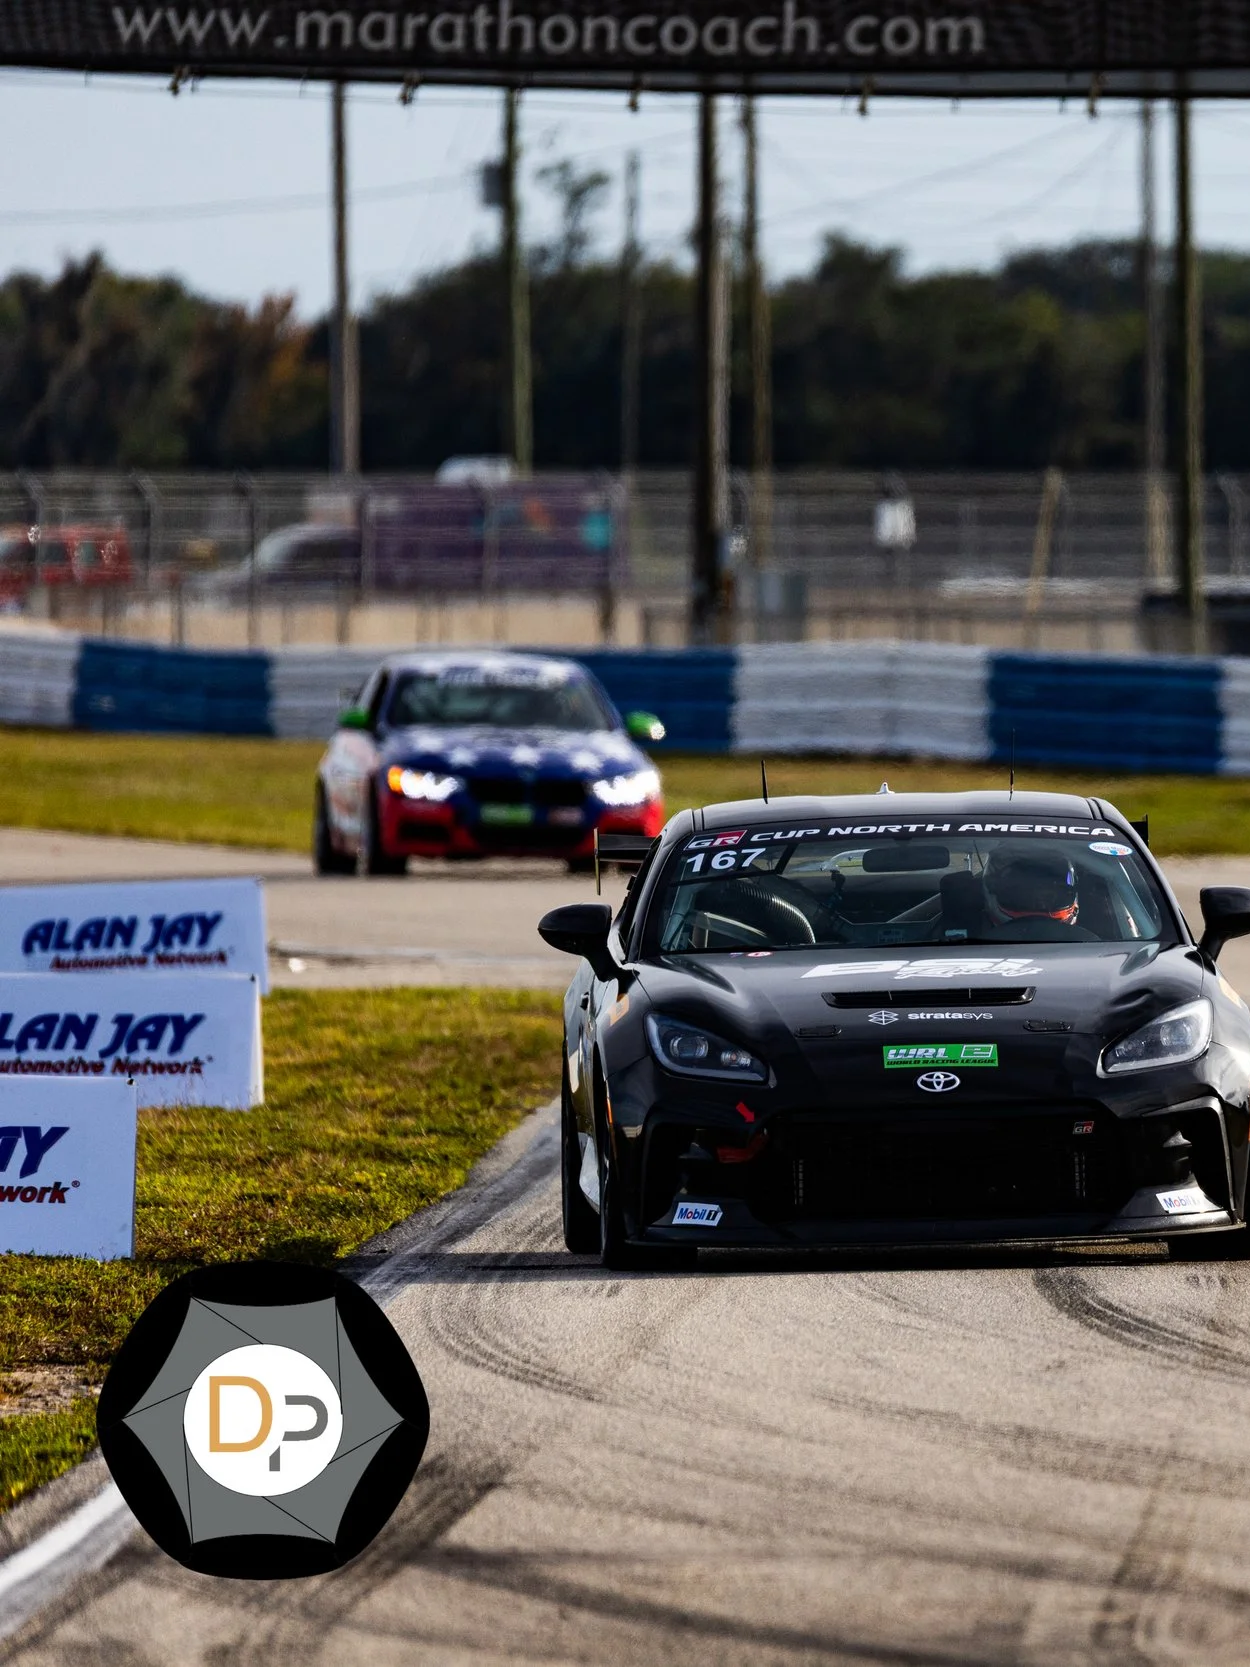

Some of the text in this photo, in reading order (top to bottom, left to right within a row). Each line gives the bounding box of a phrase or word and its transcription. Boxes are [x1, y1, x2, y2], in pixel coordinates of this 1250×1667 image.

[112, 1, 985, 56] www.marathoncoach.com
[750, 828, 820, 842] CUP
[827, 823, 951, 836] NORTH
[958, 822, 1115, 837] AMERICA
[686, 847, 767, 873] 167
[22, 911, 224, 956] ALAN JAY
[907, 1011, 994, 1021] stratasys
[98, 1012, 207, 1059] JAY
[886, 1046, 949, 1060] WRL
[677, 1207, 707, 1220] Mobil
